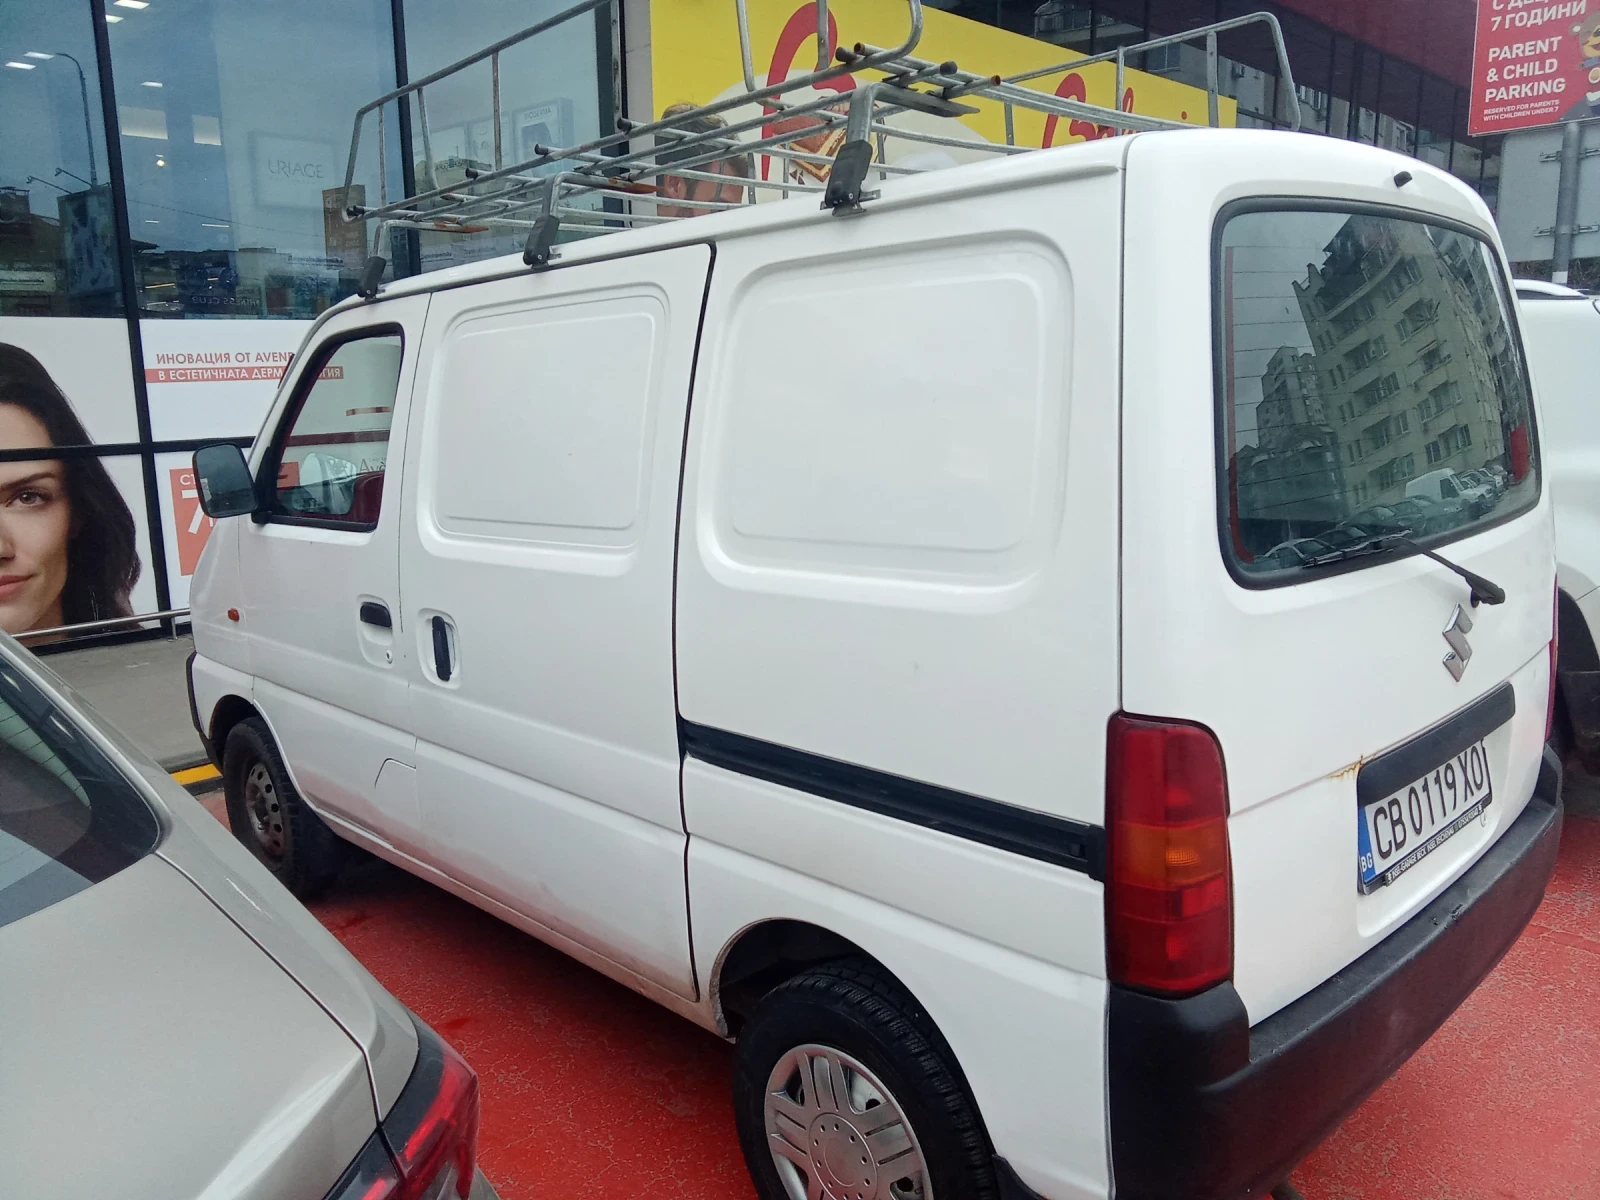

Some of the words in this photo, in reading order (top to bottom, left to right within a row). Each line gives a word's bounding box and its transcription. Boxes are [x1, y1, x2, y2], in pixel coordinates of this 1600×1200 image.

[1491, 16, 1502, 31] 7
[1504, 0, 1587, 29] ГОДИНИ
[1488, 36, 1562, 62] PARENT
[1486, 68, 1499, 83] &
[1503, 58, 1558, 80] CHILD
[1485, 78, 1566, 103] PARKING
[1483, 105, 1516, 115] RESERVED
[1516, 103, 1529, 111] FOR
[1530, 99, 1560, 109] PARENTS
[1483, 114, 1500, 122] WITH
[1500, 110, 1531, 120] CHILDREN
[1531, 107, 1554, 115] UNDER
[268, 160, 324, 179] URIAGE
[156, 352, 231, 365] ИНОВАЦИЯ
[234, 352, 251, 363] ОТ
[158, 369, 166, 381] В
[169, 367, 249, 381] ЕСТЕТИЧНАТА
[1374, 797, 1406, 859] CB
[1408, 762, 1457, 836] 0119
[1457, 746, 1483, 802] XO
[1360, 852, 1373, 872] BG
